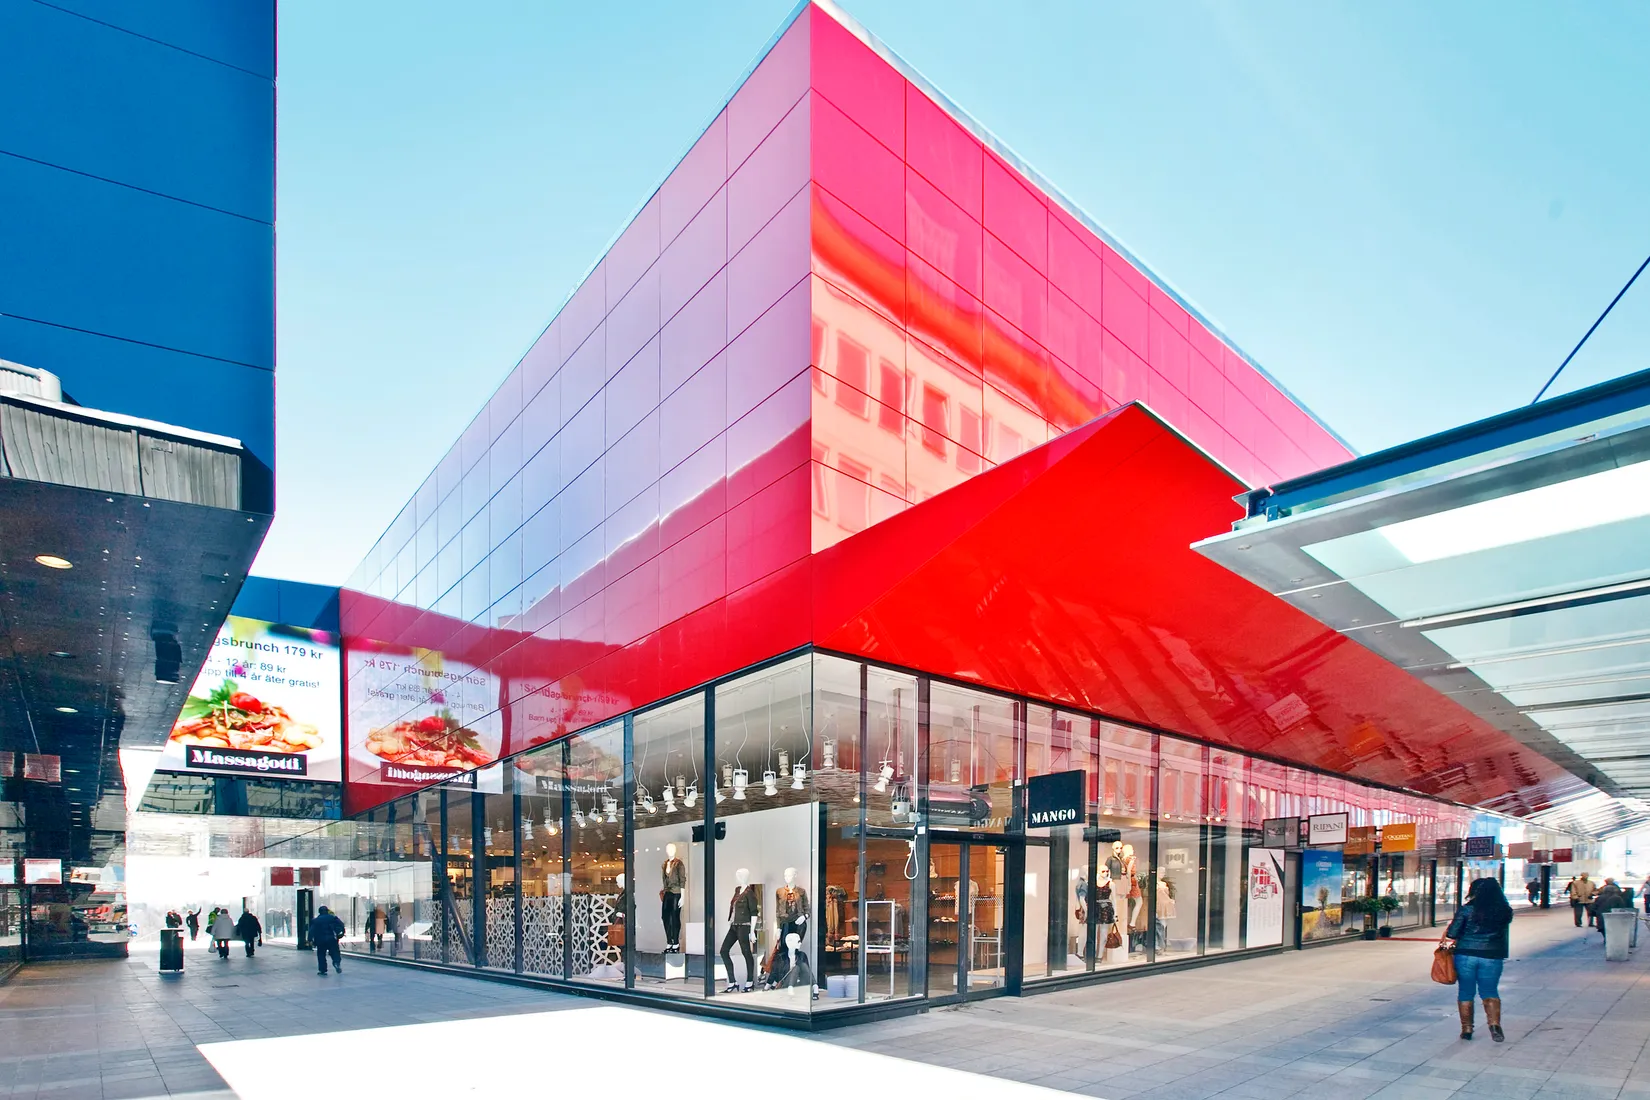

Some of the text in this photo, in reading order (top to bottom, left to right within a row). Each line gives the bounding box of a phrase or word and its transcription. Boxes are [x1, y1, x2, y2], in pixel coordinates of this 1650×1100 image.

[284, 645, 306, 657] 179
[311, 650, 324, 659] kr
[226, 658, 239, 667] 12
[260, 663, 273, 672] 89
[276, 665, 287, 674] kr
[288, 678, 320, 688] gratis!
[1031, 808, 1077, 824] MANGO
[1313, 822, 1344, 831] RIPANI
